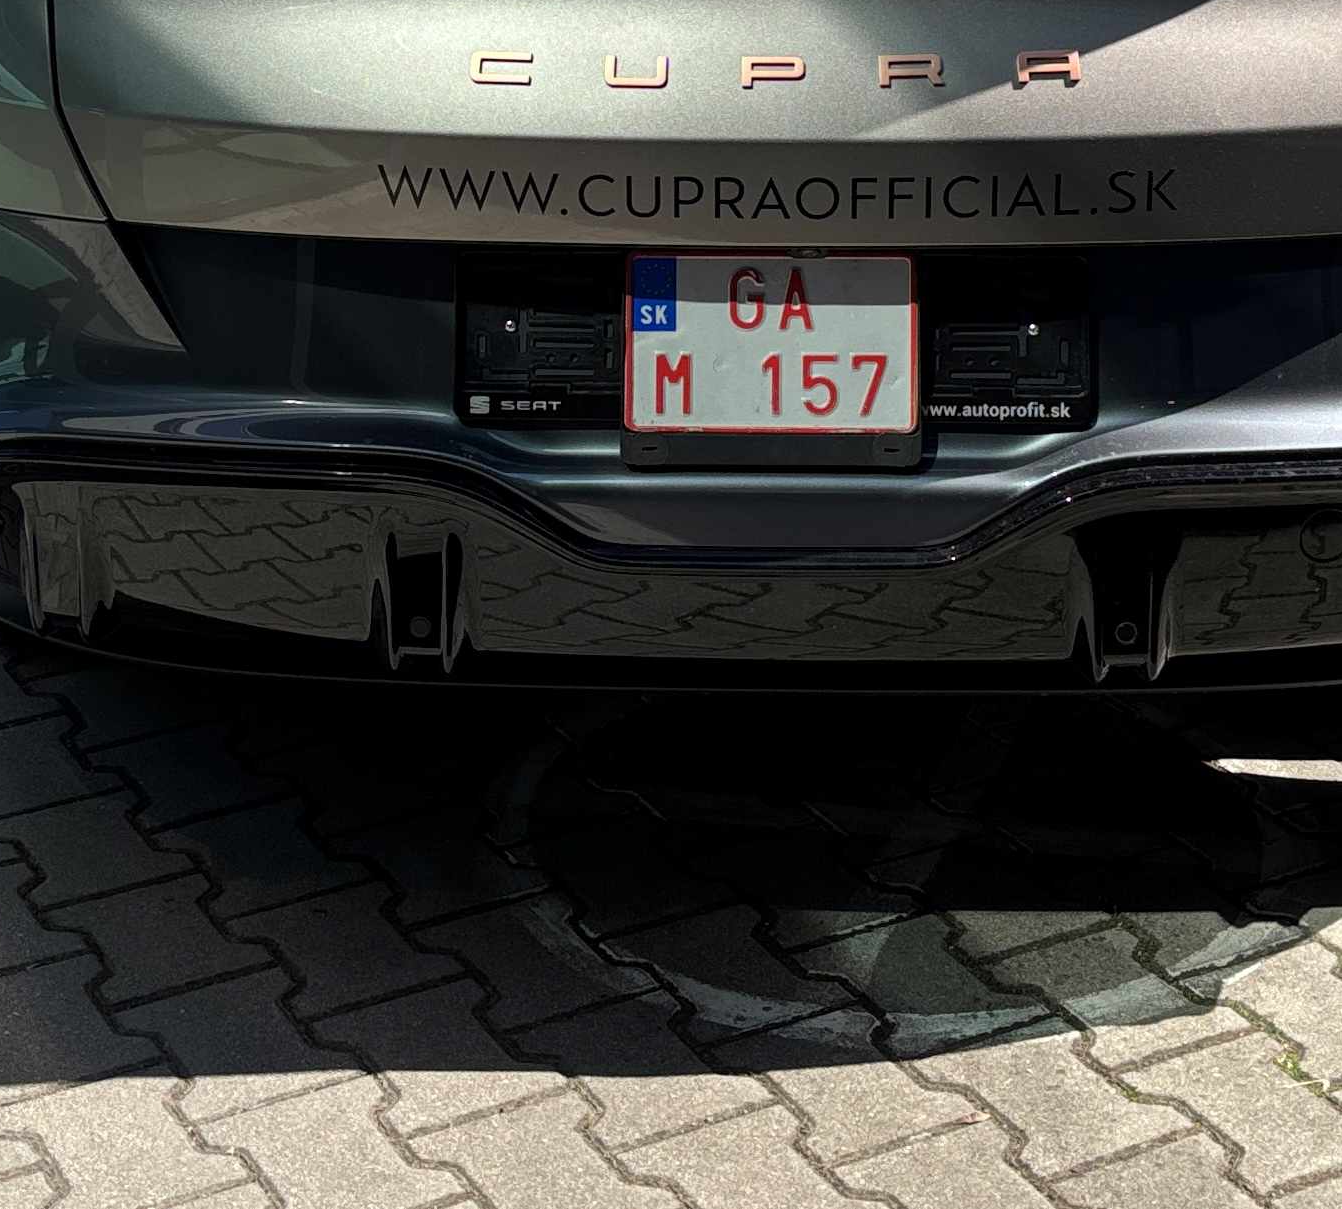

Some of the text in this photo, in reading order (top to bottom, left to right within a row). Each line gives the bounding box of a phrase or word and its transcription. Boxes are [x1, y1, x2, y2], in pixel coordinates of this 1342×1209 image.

[469, 49, 1083, 88] CUPRA
[377, 165, 1178, 221] WWW.CUPRAOFFICIAL.SK
[640, 304, 668, 325] SK
[728, 268, 814, 331] GA
[500, 400, 561, 411] SEAT
[656, 353, 888, 417] M 157
